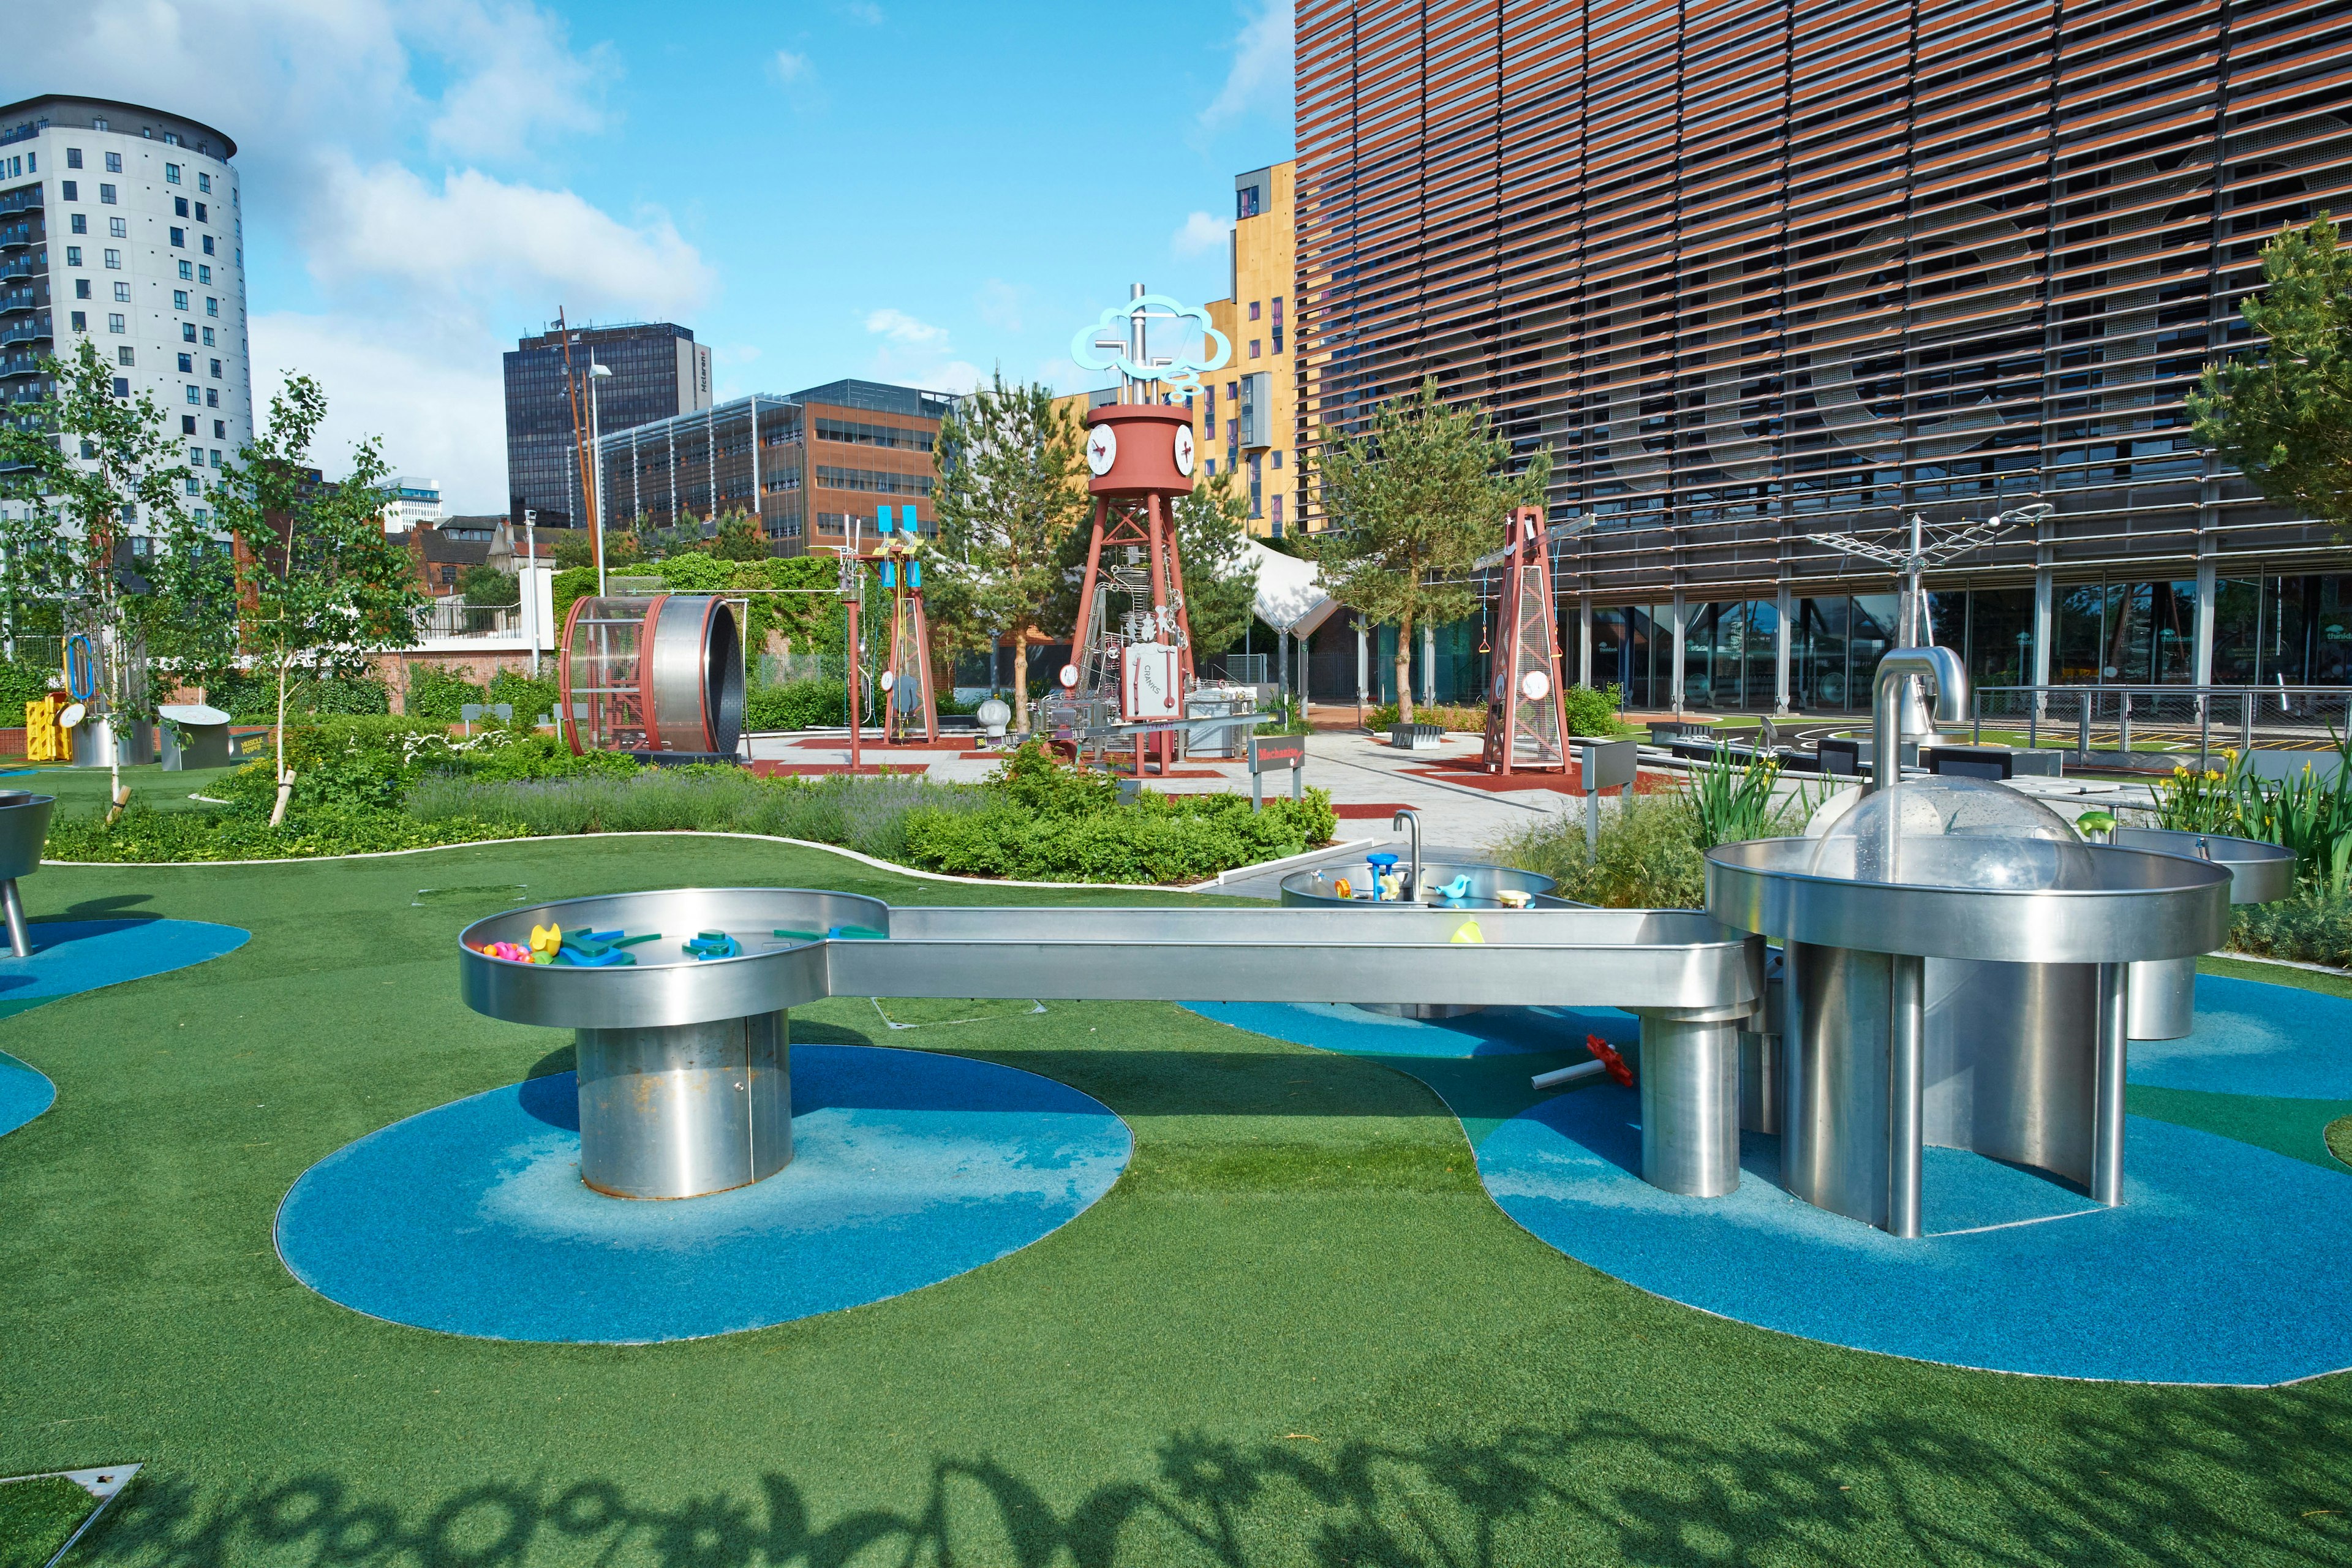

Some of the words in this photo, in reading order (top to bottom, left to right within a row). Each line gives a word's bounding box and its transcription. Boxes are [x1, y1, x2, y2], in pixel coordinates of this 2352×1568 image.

[1144, 665, 1161, 695] CRANKS
[241, 736, 264, 749] MUSCLE
[242, 744, 262, 755] POWER
